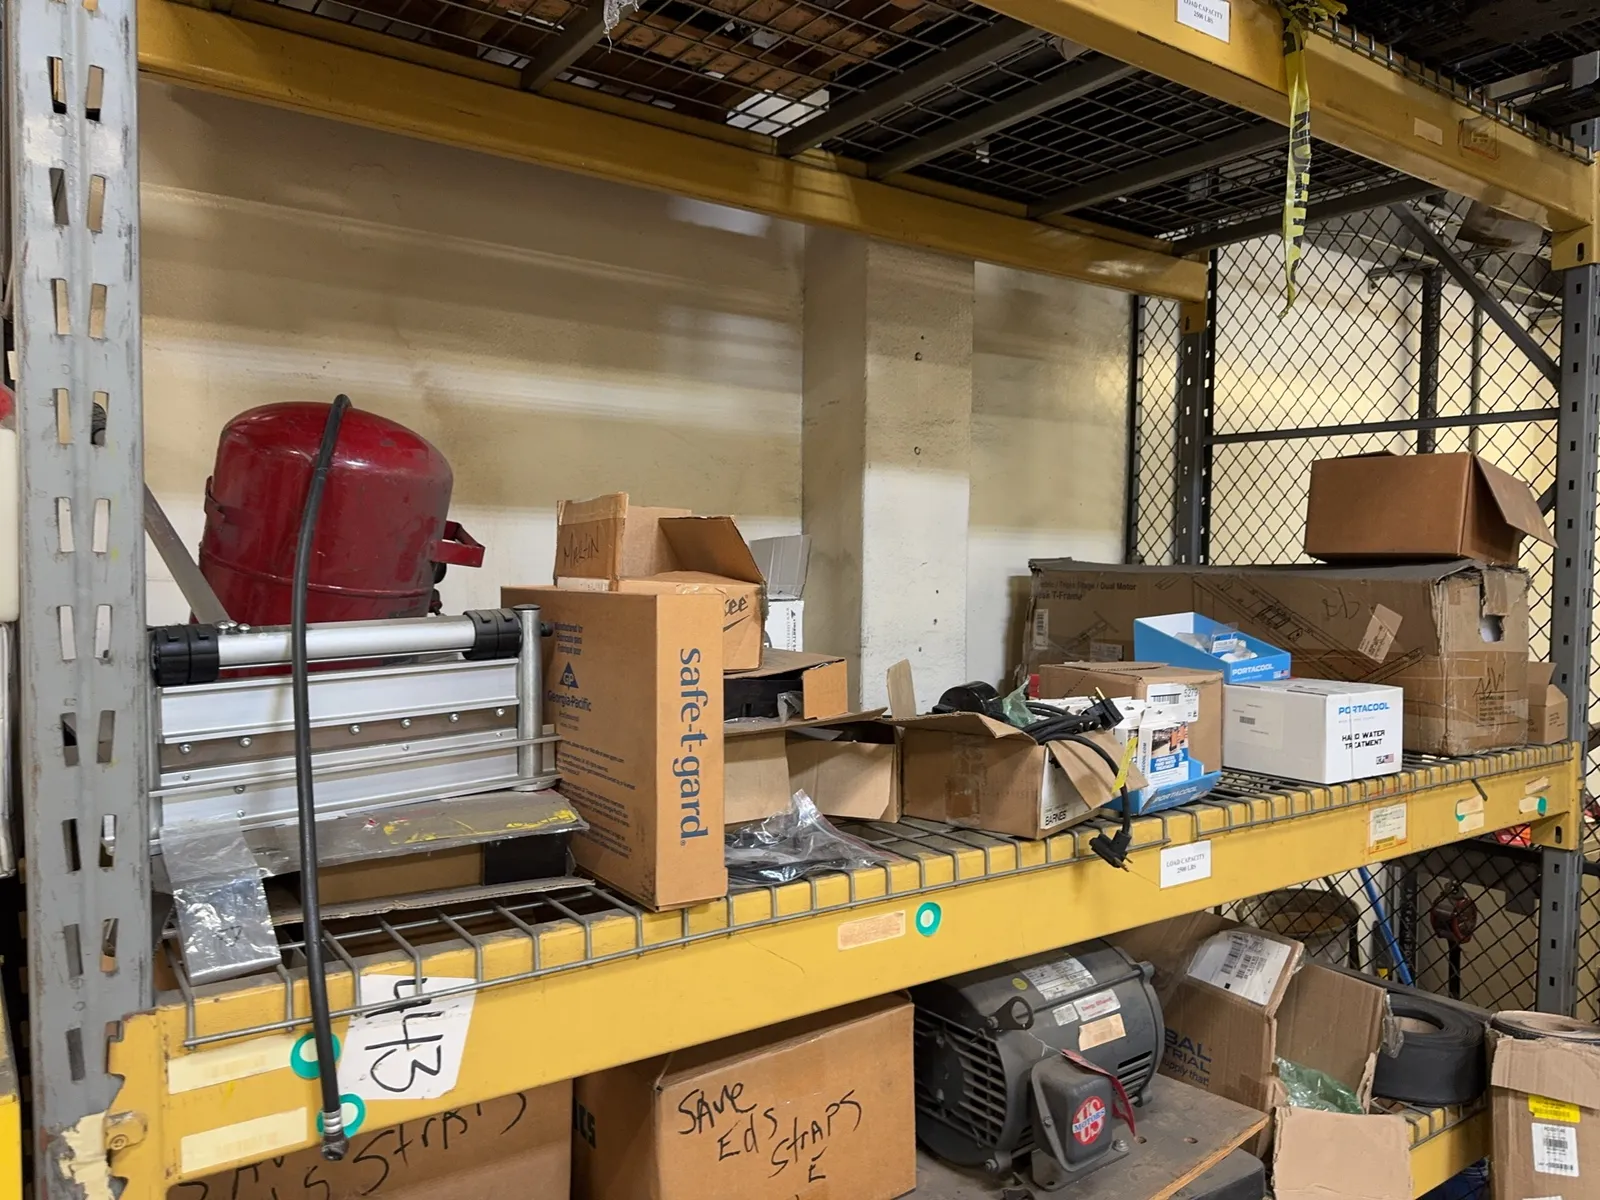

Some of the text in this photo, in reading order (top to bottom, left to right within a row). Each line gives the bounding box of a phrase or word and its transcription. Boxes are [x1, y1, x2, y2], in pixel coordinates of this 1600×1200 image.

[1198, 4, 1223, 19] CAPACITY
[1100, 582, 1115, 590] Dual
[1231, 663, 1275, 675] PORTACOOL
[1337, 702, 1390, 715] PORTACOOL
[1342, 729, 1386, 741] HAD WATER
[673, 648, 708, 838] safe-t-gard
[1045, 811, 1068, 826] BARNES
[1181, 854, 1205, 864] CAPACITY
[365, 977, 445, 1093] 443
